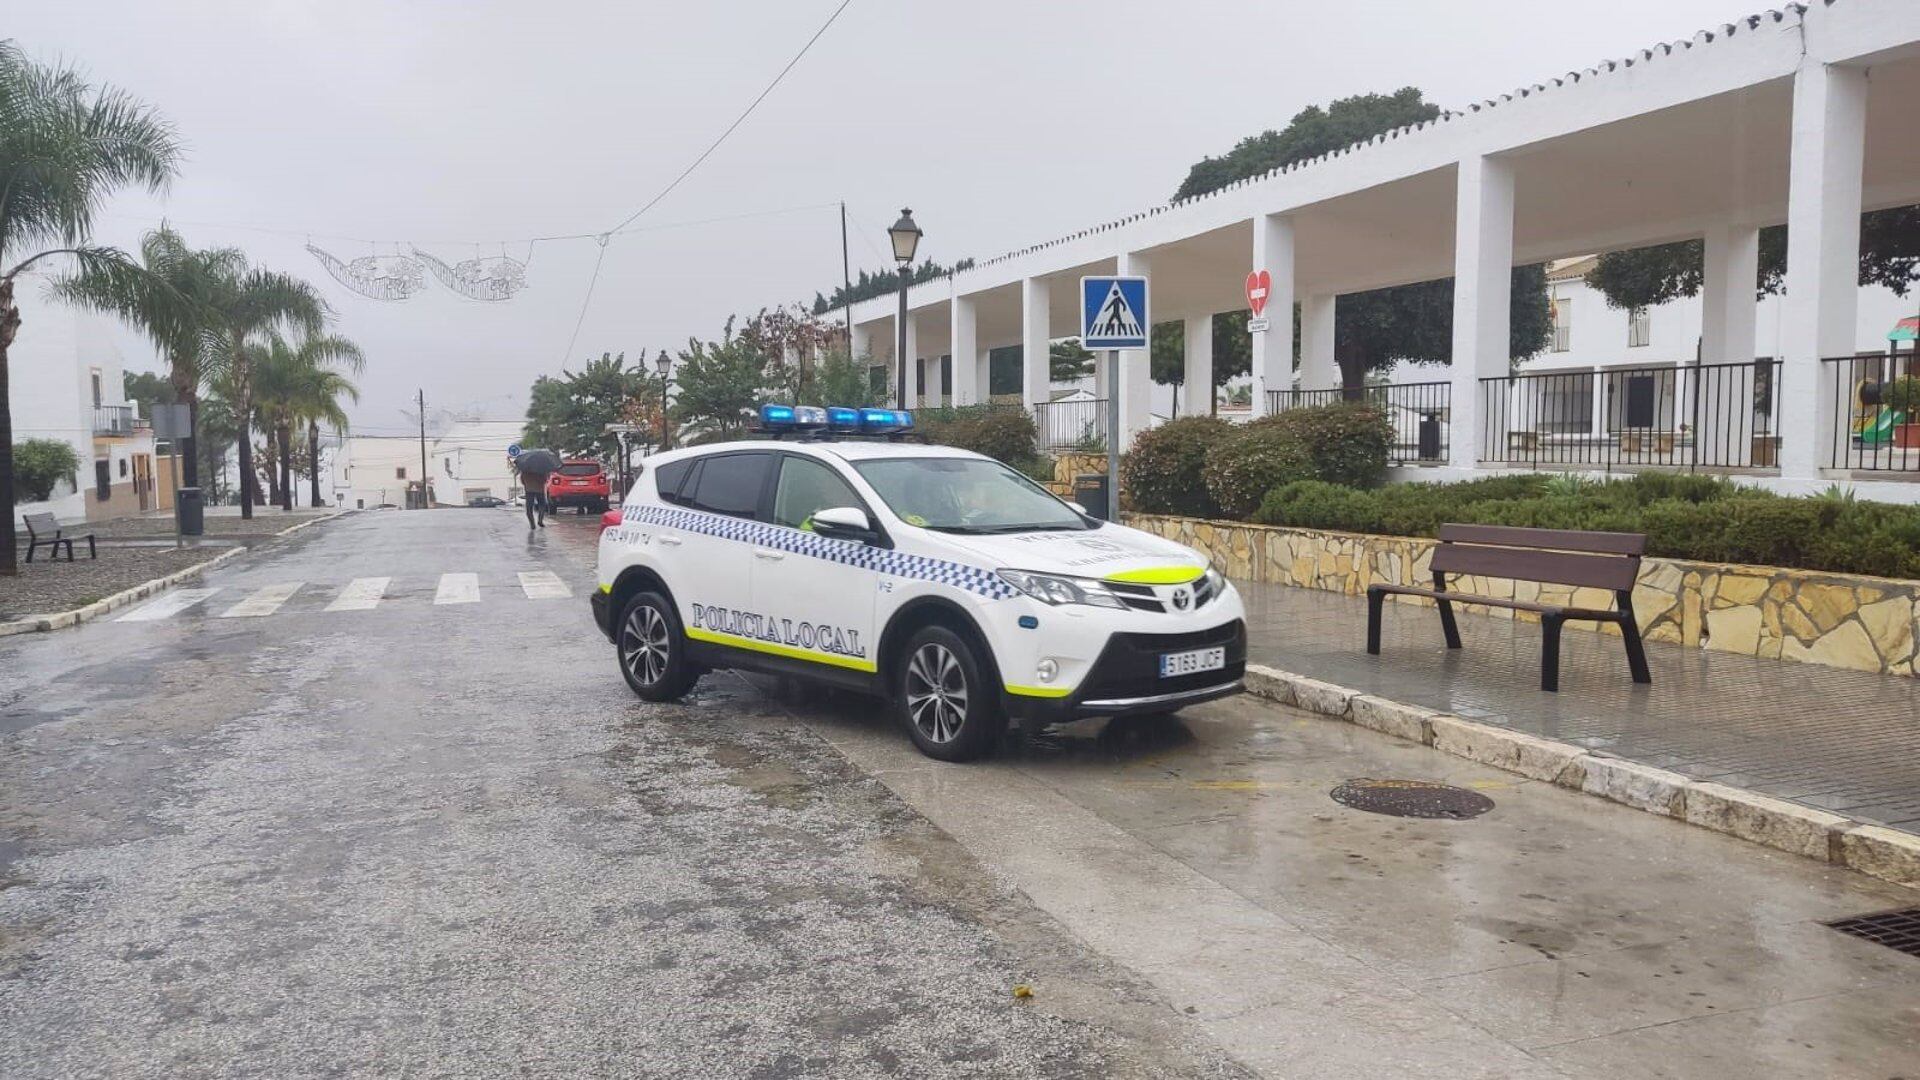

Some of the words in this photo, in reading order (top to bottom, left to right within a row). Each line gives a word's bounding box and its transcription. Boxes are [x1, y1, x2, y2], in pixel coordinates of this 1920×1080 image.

[692, 602, 781, 643] POLICIA
[782, 618, 866, 659] LOCAL
[1168, 653, 1197, 673] 5163
